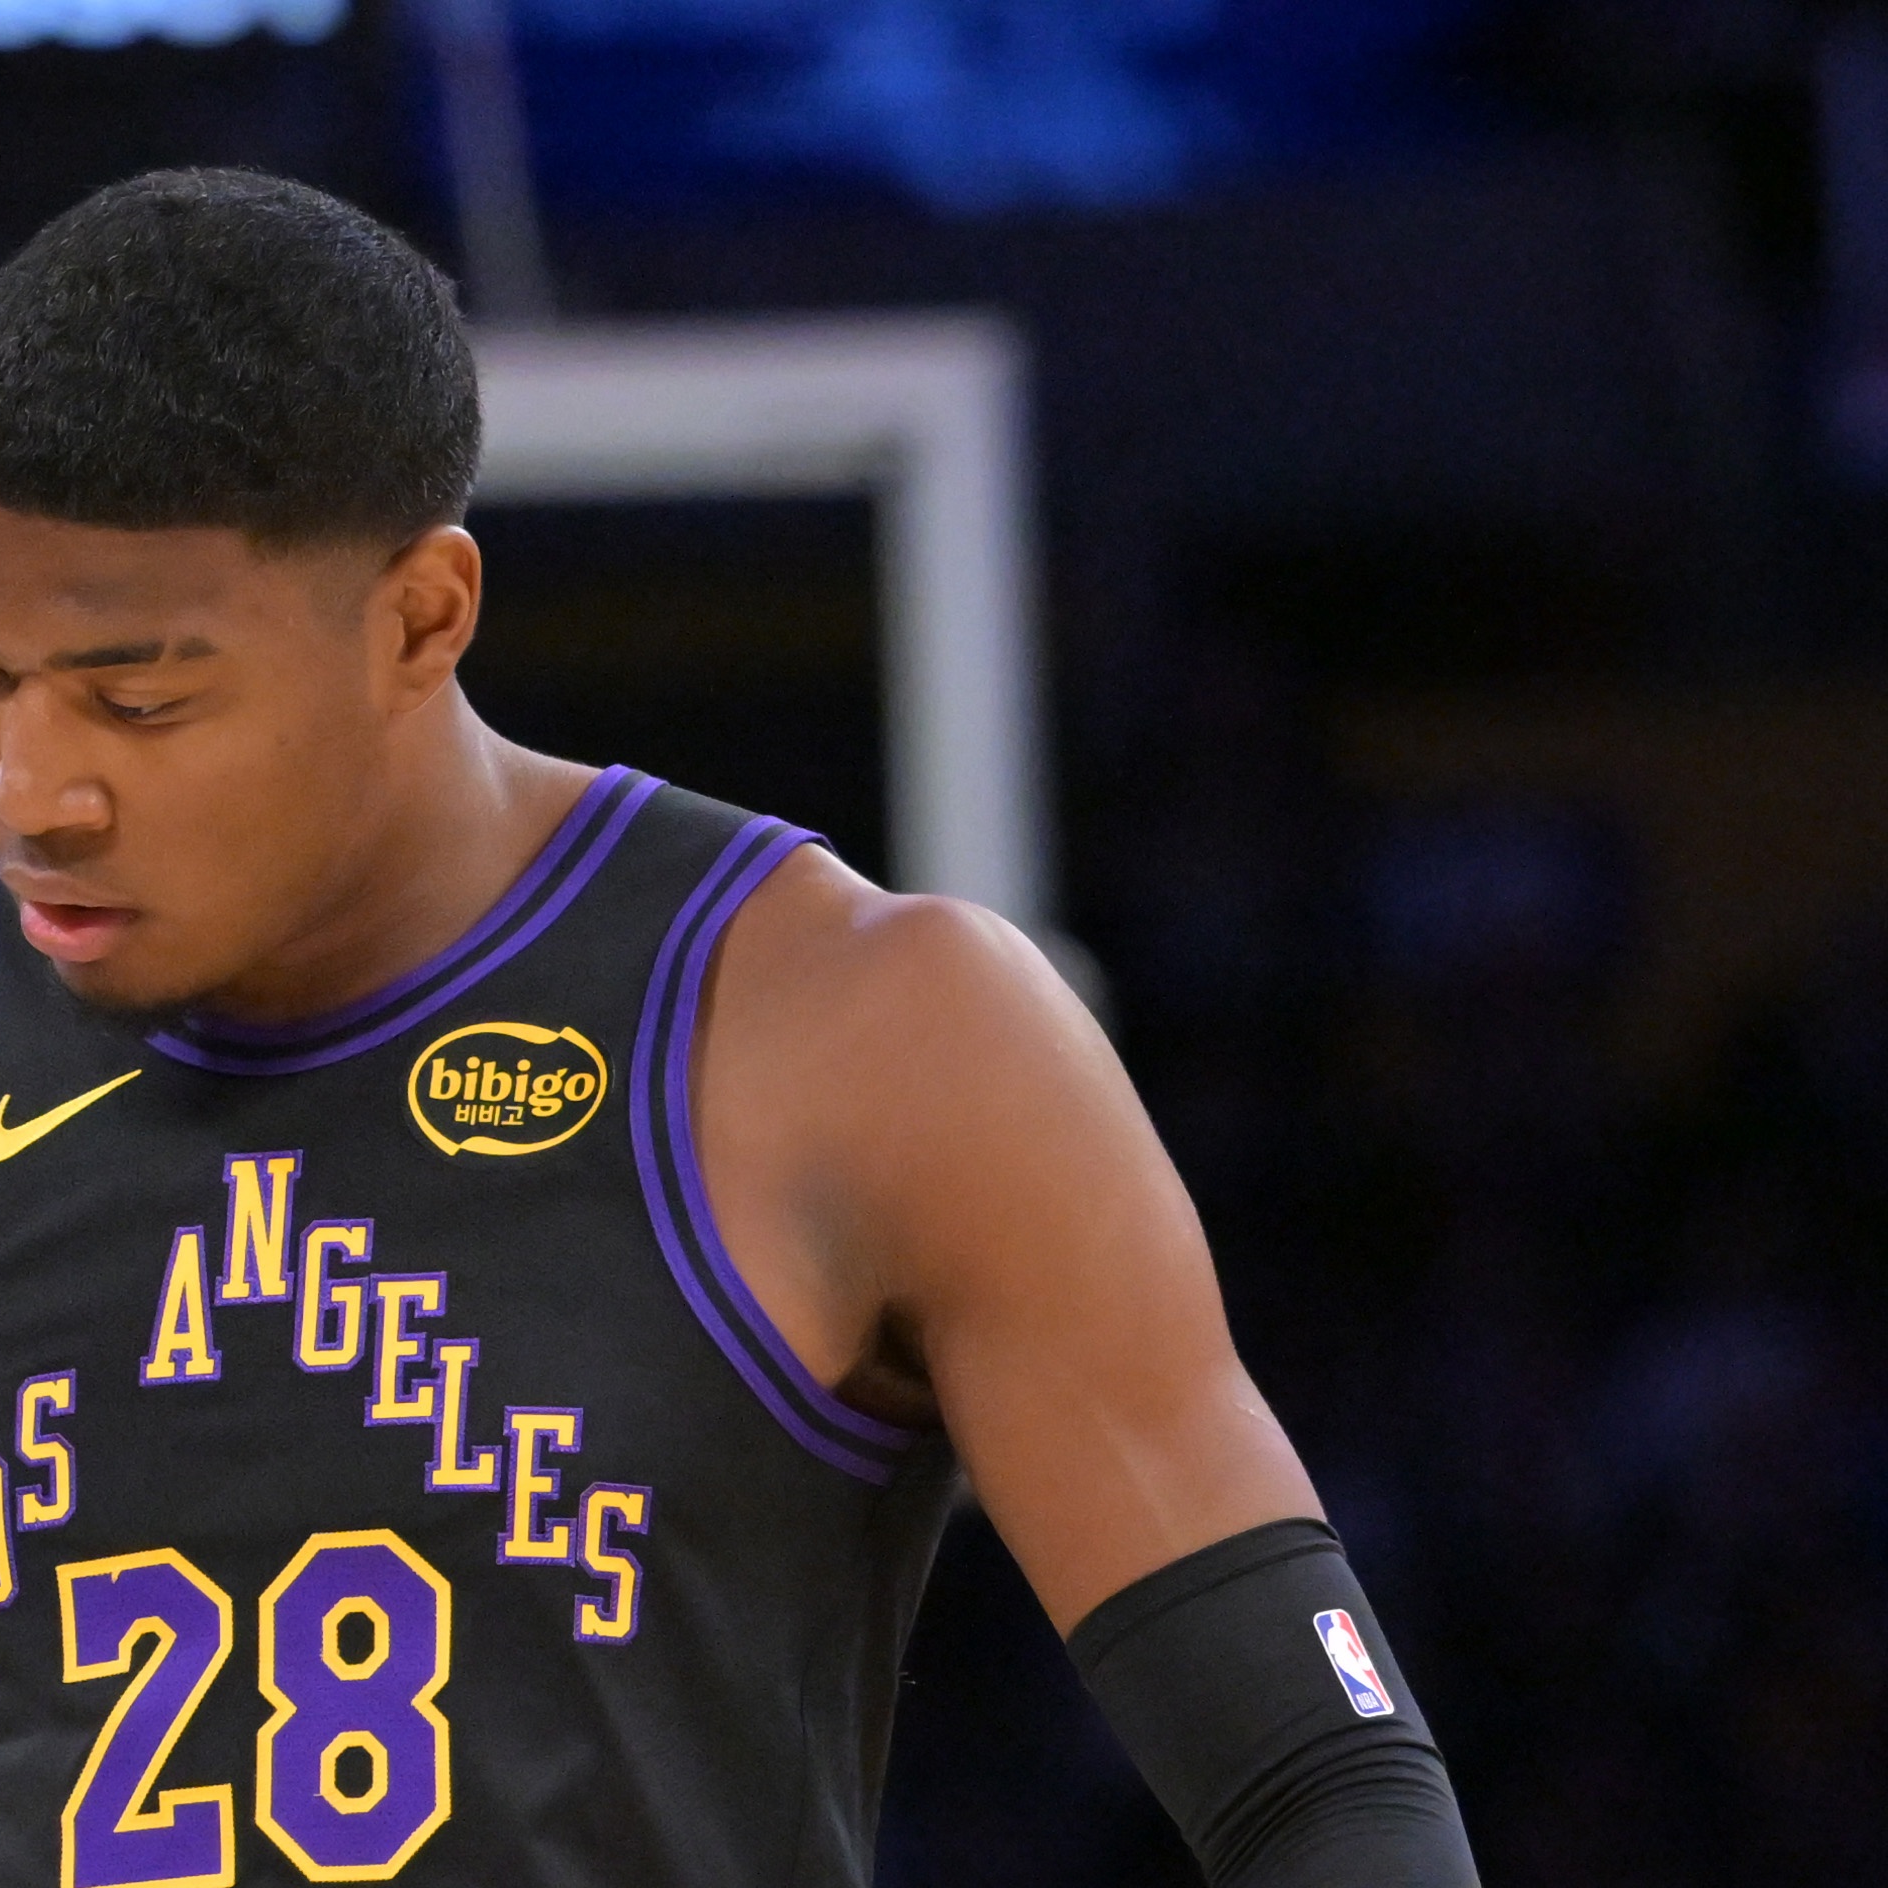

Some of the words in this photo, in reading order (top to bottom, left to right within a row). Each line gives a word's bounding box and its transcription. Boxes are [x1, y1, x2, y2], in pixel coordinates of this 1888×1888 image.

[429, 1056, 596, 1118] bibigo
[454, 1104, 525, 1126] 비비고
[138, 1149, 653, 1646] ANGELES
[1356, 1691, 1380, 1710] NBA
